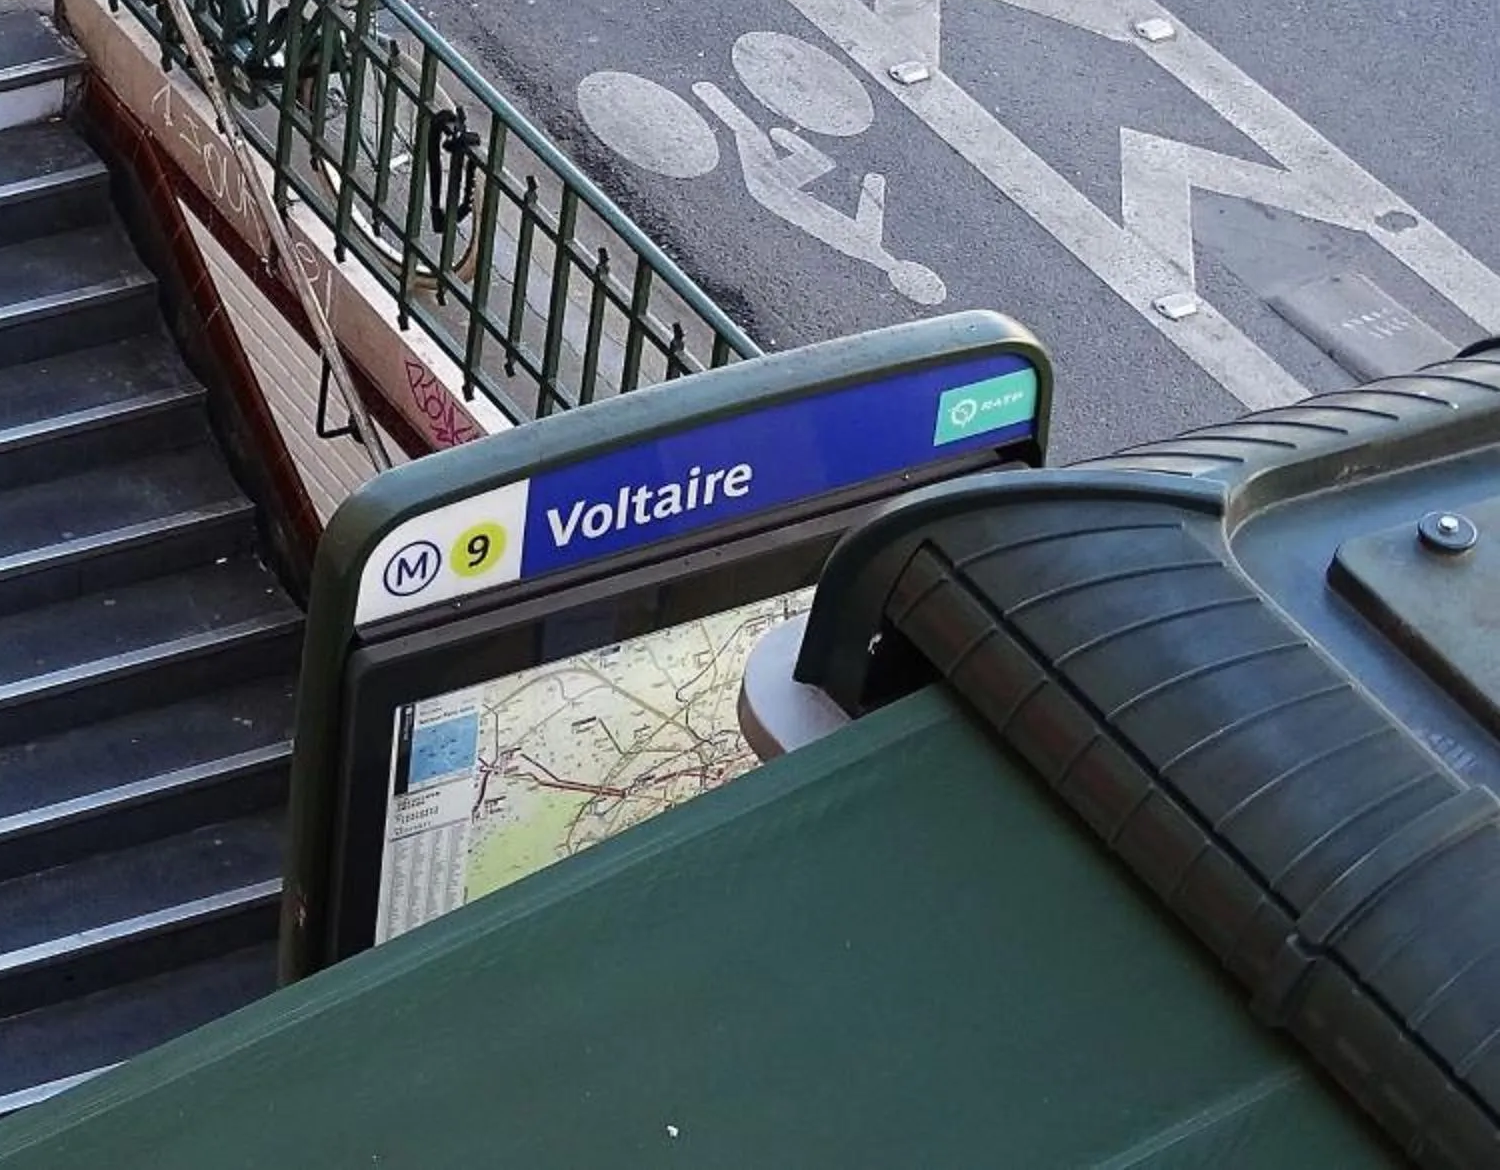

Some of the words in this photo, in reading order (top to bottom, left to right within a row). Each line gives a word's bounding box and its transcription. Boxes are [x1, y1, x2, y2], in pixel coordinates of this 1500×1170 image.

[979, 390, 1025, 412] RATP
[466, 534, 491, 568] 9
[546, 461, 754, 548] Voltaire
